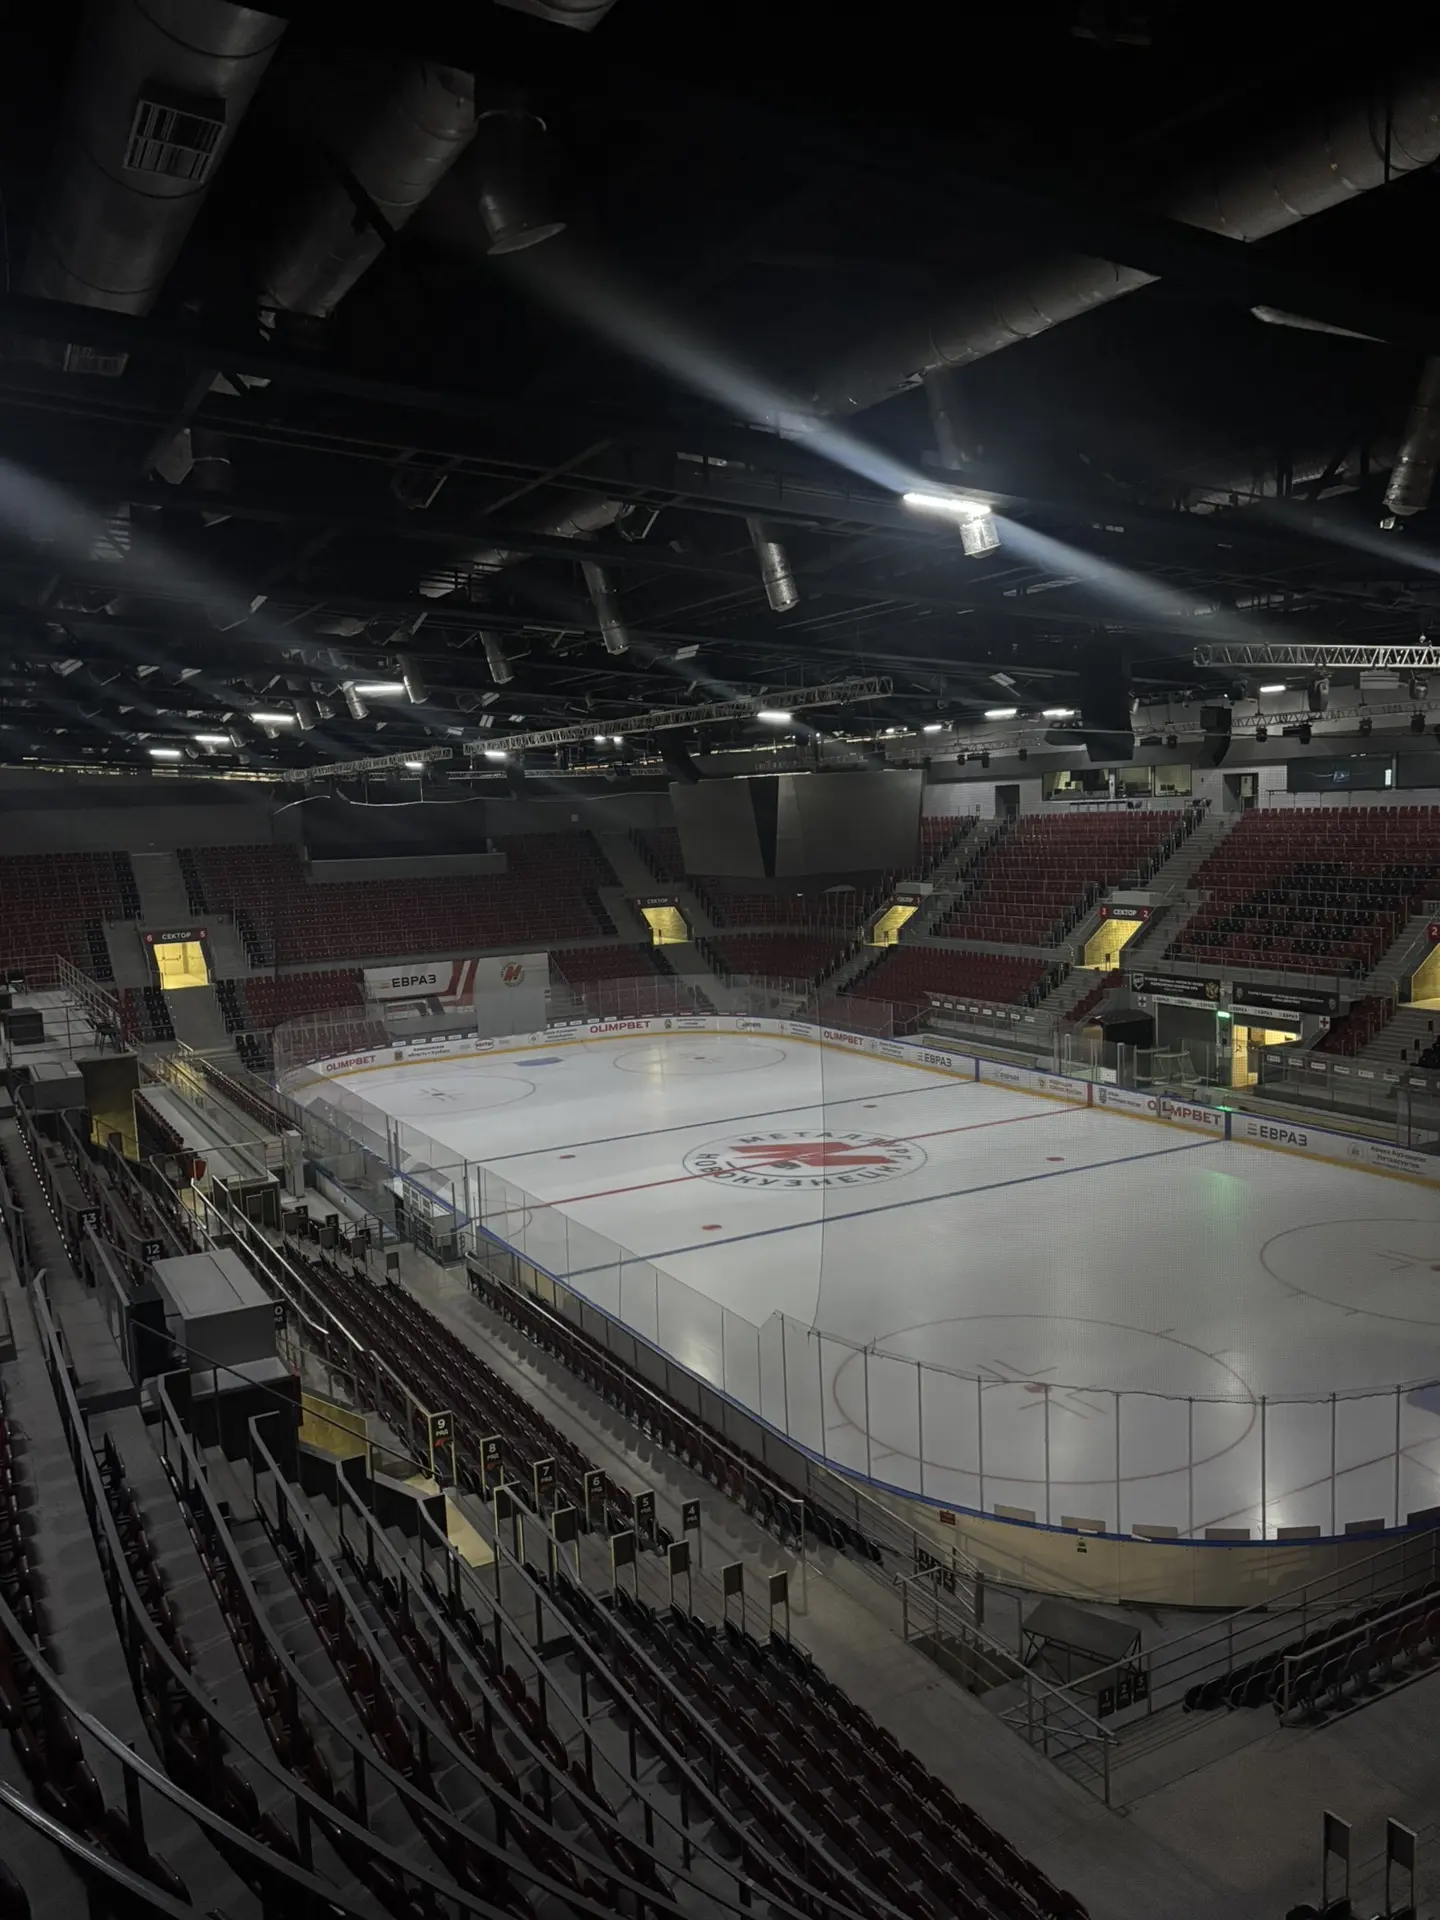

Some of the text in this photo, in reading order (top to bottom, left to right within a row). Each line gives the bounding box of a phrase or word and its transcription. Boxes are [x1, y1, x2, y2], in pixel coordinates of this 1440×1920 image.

[1113, 908, 1138, 917] СЕКТОР
[146, 930, 206, 942] 6 СЕКТОР 5
[1431, 926, 1438, 936] 2
[391, 974, 437, 989] ЕВРАЗ
[589, 1020, 652, 1034] OLIMPBET
[823, 1030, 865, 1046] OLIMPBET
[326, 1054, 377, 1073] OLIMPBET
[924, 1052, 953, 1068] ЕВРАЗ
[1259, 1125, 1308, 1147] ЕВРАЗ
[81, 1212, 98, 1224] 13
[146, 1243, 161, 1255] 12
[437, 1419, 446, 1430] 9
[488, 1442, 497, 1453] 8
[542, 1465, 551, 1477] 7
[592, 1477, 601, 1487] 6
[642, 1496, 650, 1507] 5
[688, 1505, 696, 1515] 4
